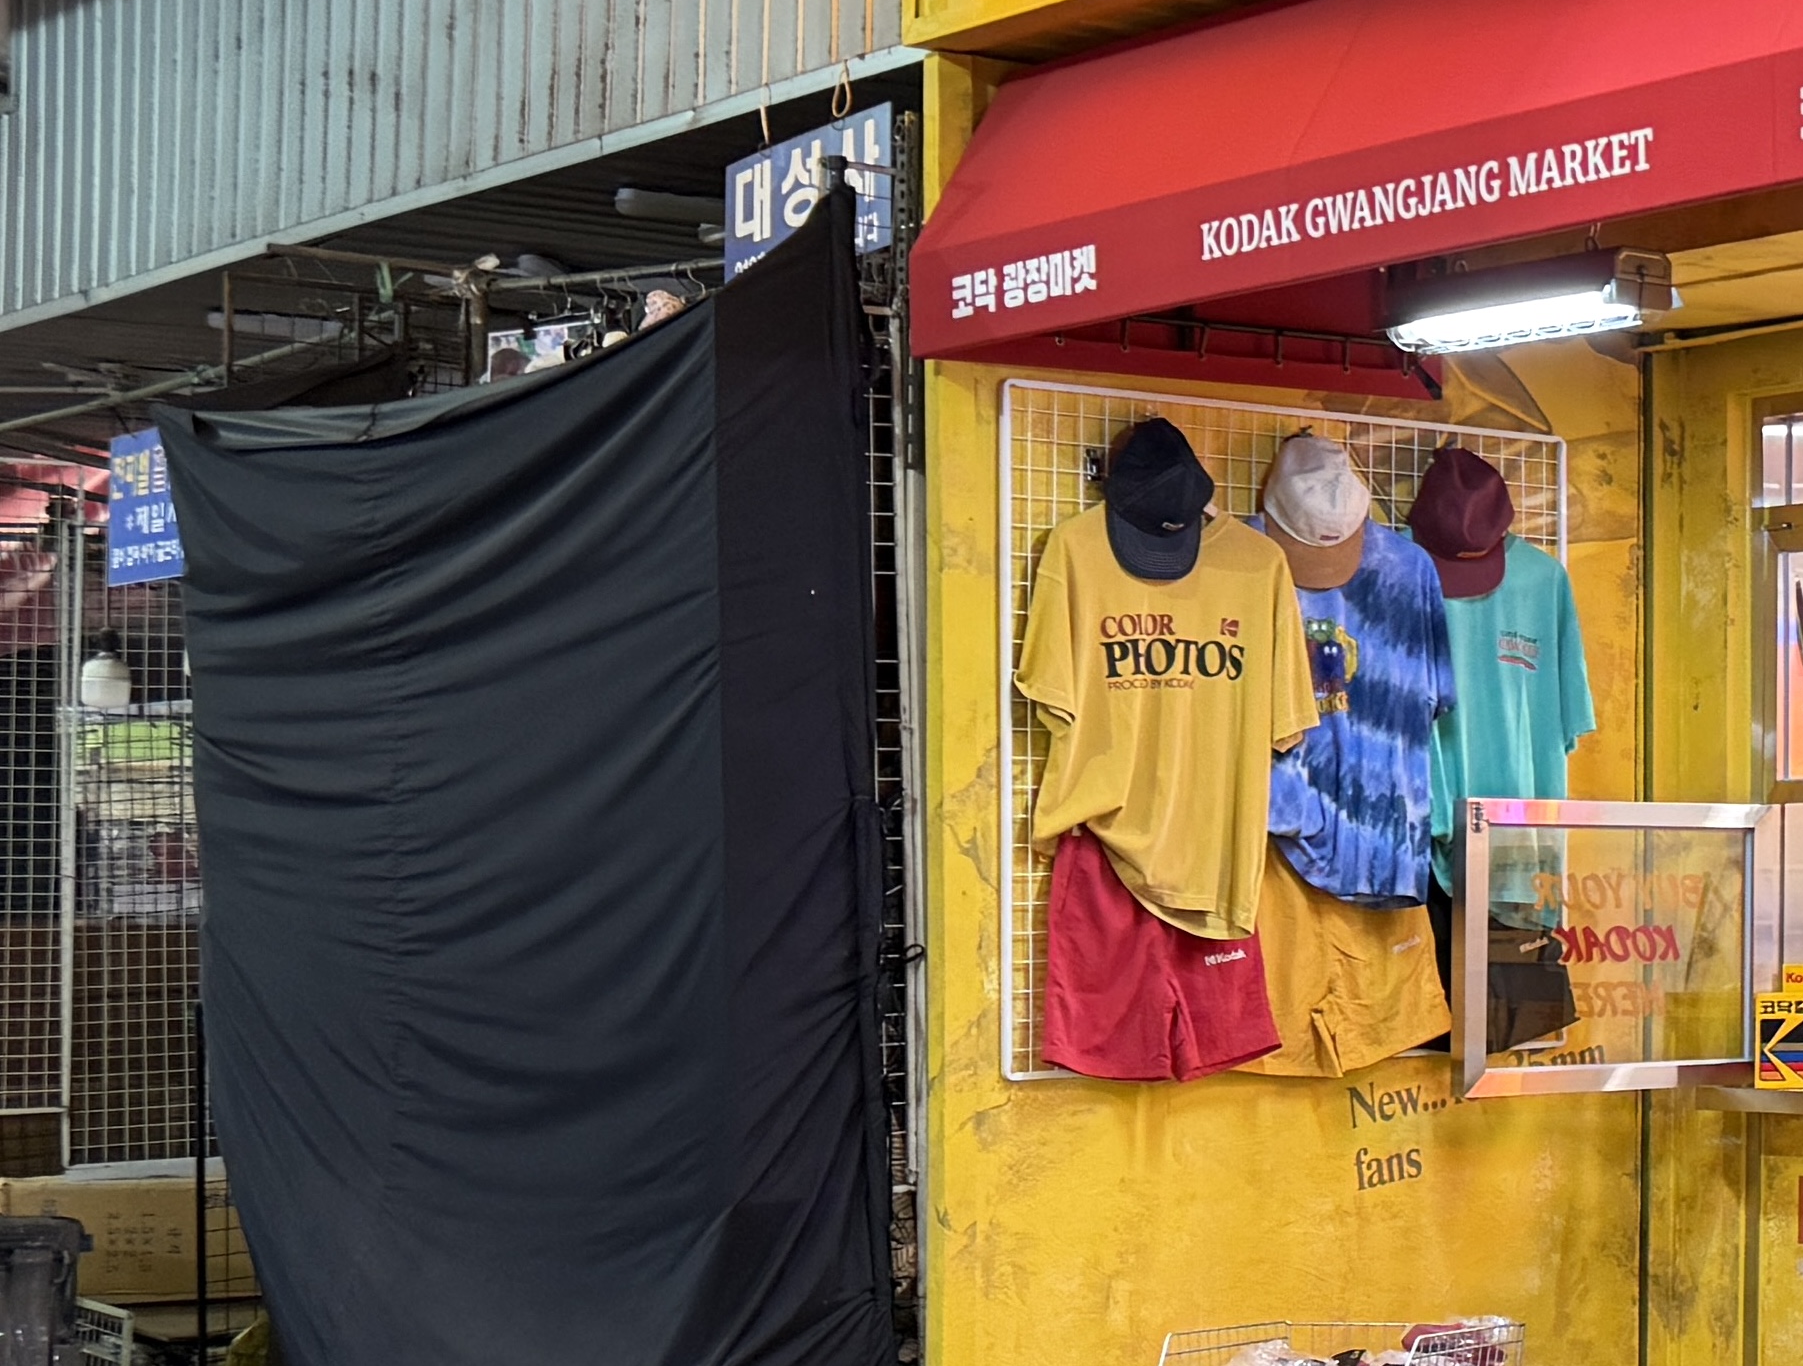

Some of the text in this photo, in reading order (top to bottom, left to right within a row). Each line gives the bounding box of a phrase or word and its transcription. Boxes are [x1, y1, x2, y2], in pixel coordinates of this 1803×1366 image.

[1200, 128, 1655, 262] KODAK GWANGJANG MARKET
[951, 243, 1098, 319] 코닥 광장마켓
[1101, 613, 1176, 639] COLOR
[1100, 637, 1245, 681] PHOTOS
[1346, 1081, 1448, 1130] New...
[1354, 1146, 1423, 1192] fans
